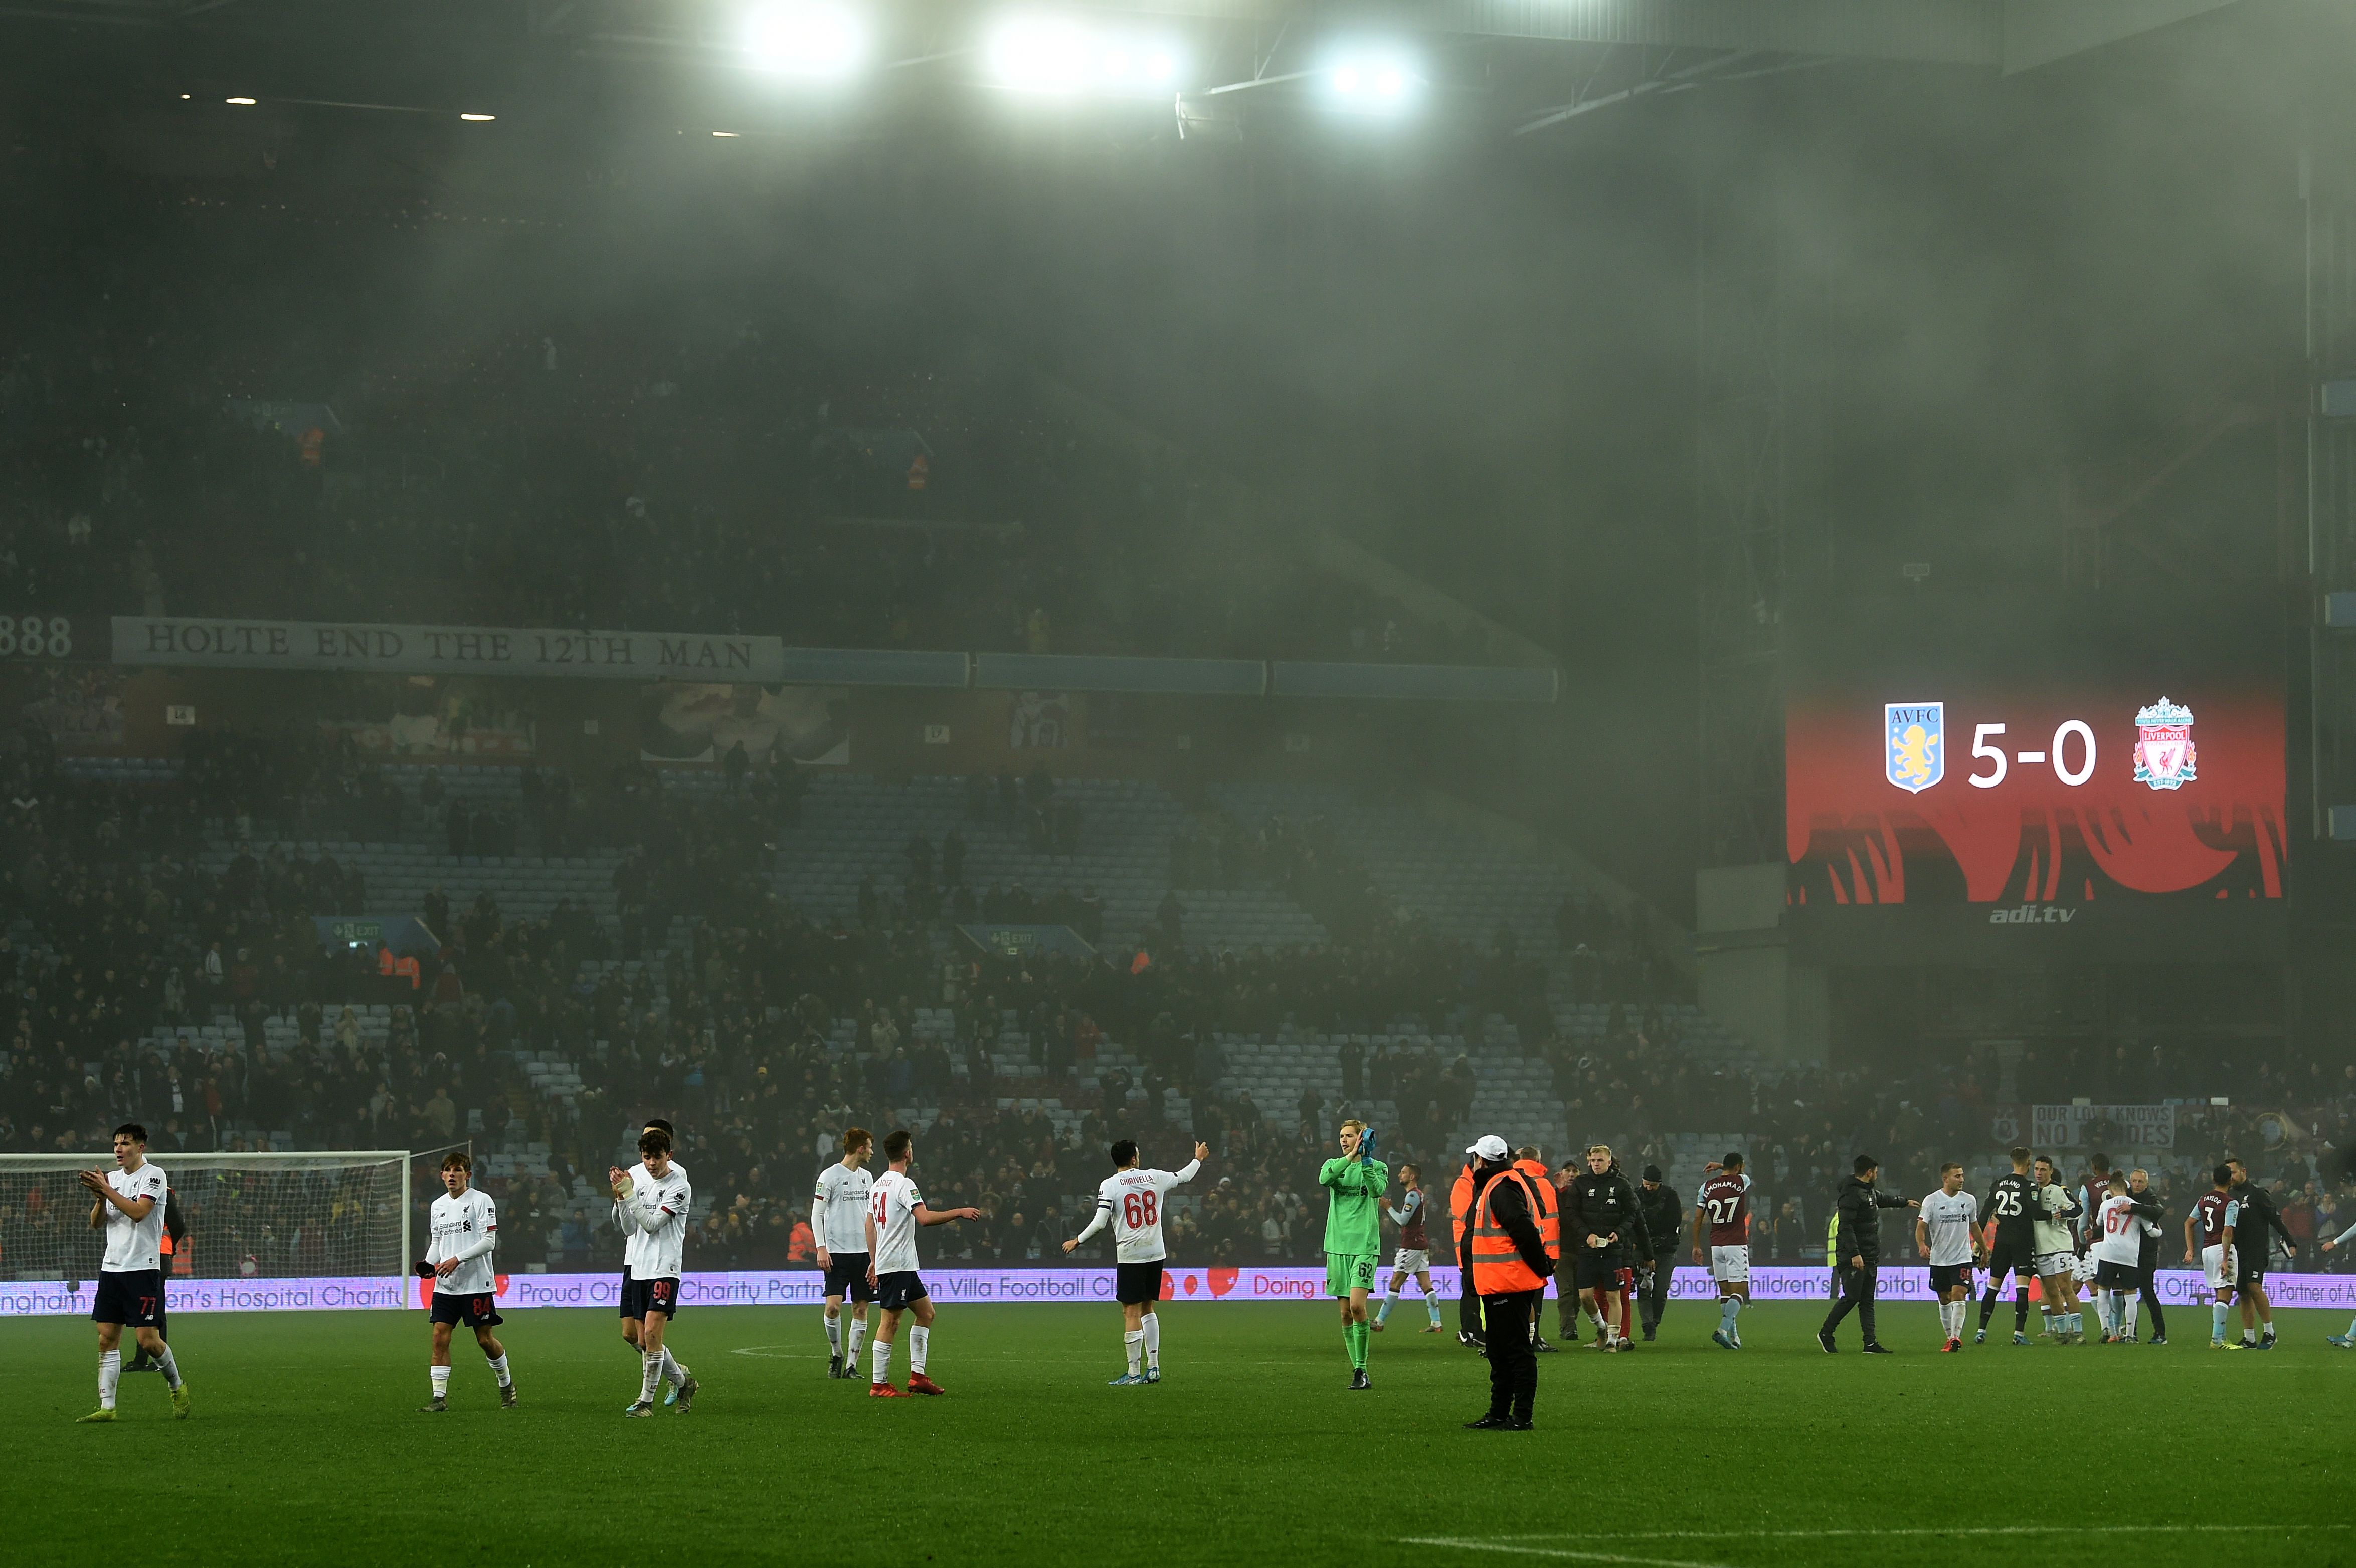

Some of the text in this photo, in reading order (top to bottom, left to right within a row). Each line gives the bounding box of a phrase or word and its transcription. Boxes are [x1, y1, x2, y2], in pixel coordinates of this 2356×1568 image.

[145, 624, 752, 669] HOLTE END THE 12TH MAN
[1892, 709, 1939, 723] AVFC
[2144, 731, 2186, 740] LIVERPOOL
[1968, 719, 2097, 789] 5-0
[1990, 904, 2076, 923] adi.tv
[357, 926, 380, 936] EXIT
[1012, 934, 1032, 943] EXIT
[2038, 1107, 2067, 1121] OUR
[2116, 1107, 2170, 1121] KNOWS
[2037, 1124, 2068, 1144] NO
[1120, 1175, 1153, 1186] CHIRIVELLA
[1703, 1181, 1744, 1198] ELMOHAMADY
[1999, 1179, 2021, 1189] NYLAND
[1995, 1190, 2023, 1216] 25
[2203, 1195, 2222, 1205] TAYLOR
[1124, 1190, 1158, 1229] 68
[1707, 1196, 1740, 1224] 27
[440, 1220, 461, 1229] Standard
[2106, 1207, 2134, 1235] 67
[2205, 1206, 2214, 1232] 3
[440, 1228, 462, 1236] Chartered
[1358, 1262, 1373, 1279] 62
[2060, 1257, 2066, 1268] 5
[520, 1282, 582, 1302] Proud
[680, 1281, 760, 1305] Charity
[949, 1277, 991, 1297] Villa
[1001, 1277, 1084, 1297] Football
[653, 1281, 671, 1300] 99
[1255, 1275, 1314, 1298] Doing
[1750, 1275, 1830, 1293] hildren's
[2280, 1281, 2324, 1301] Partner
[2329, 1284, 2342, 1301] of
[140, 1296, 157, 1314] 77
[221, 1287, 313, 1309] Hospital
[473, 1297, 491, 1316] 84
